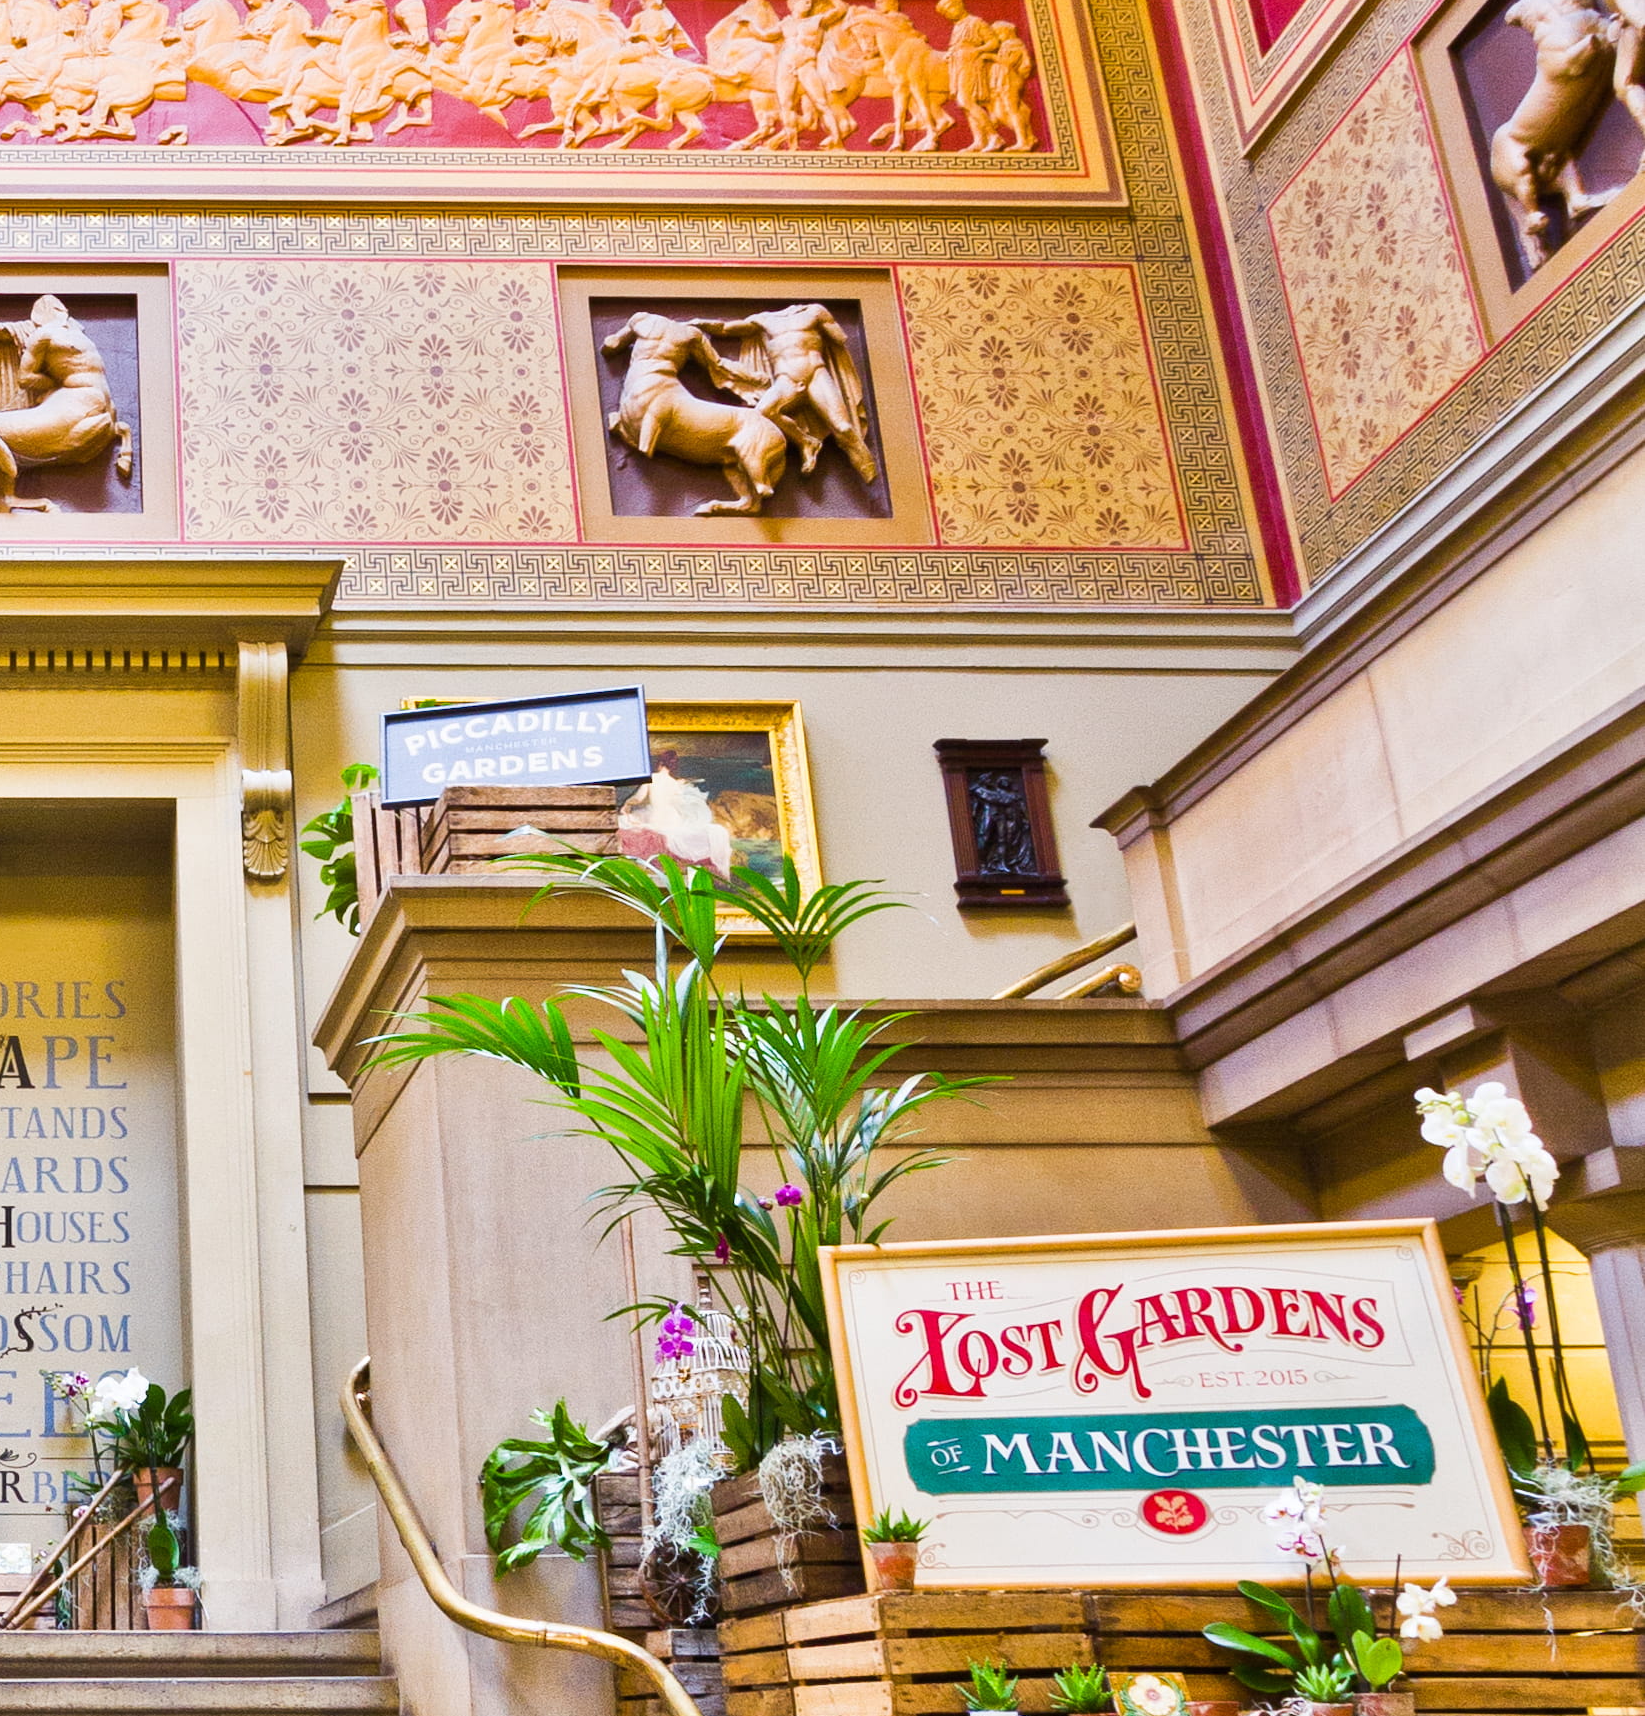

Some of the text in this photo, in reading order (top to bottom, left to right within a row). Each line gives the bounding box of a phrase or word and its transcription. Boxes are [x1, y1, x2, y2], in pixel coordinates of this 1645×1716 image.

[404, 711, 621, 757] PICCADILLY
[465, 738, 557, 754] MANCHESTER
[421, 746, 604, 784] GARDENS
[946, 1281, 1004, 1301] THE
[893, 1282, 1386, 1409] LOST GARDENS
[1199, 1368, 1309, 1389] EST. 2015
[929, 1422, 1414, 1478] OF MANCHESTER
